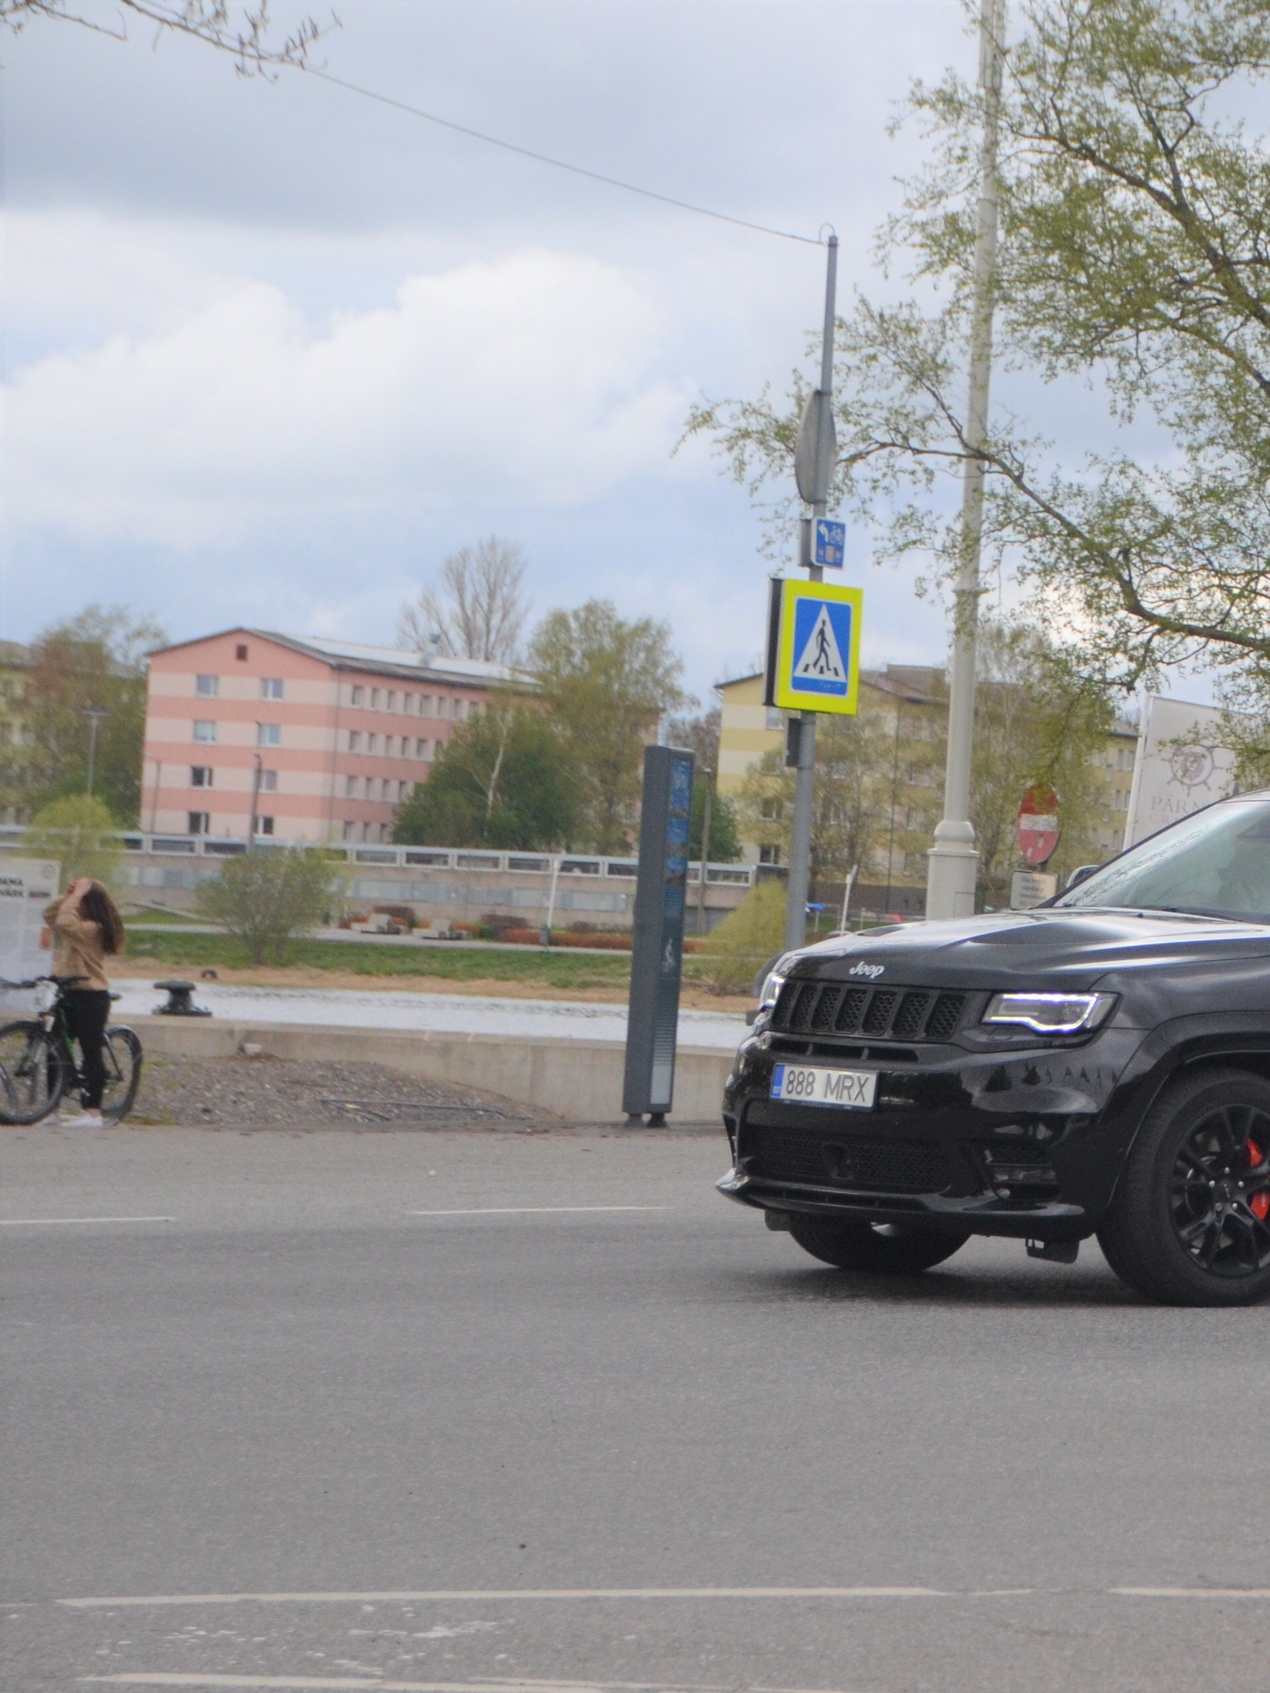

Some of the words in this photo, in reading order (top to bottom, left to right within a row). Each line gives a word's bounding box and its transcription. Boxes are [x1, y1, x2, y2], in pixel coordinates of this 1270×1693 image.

[849, 961, 885, 979] Jeep
[786, 1070, 816, 1096] 888
[824, 1073, 869, 1102] MRX
